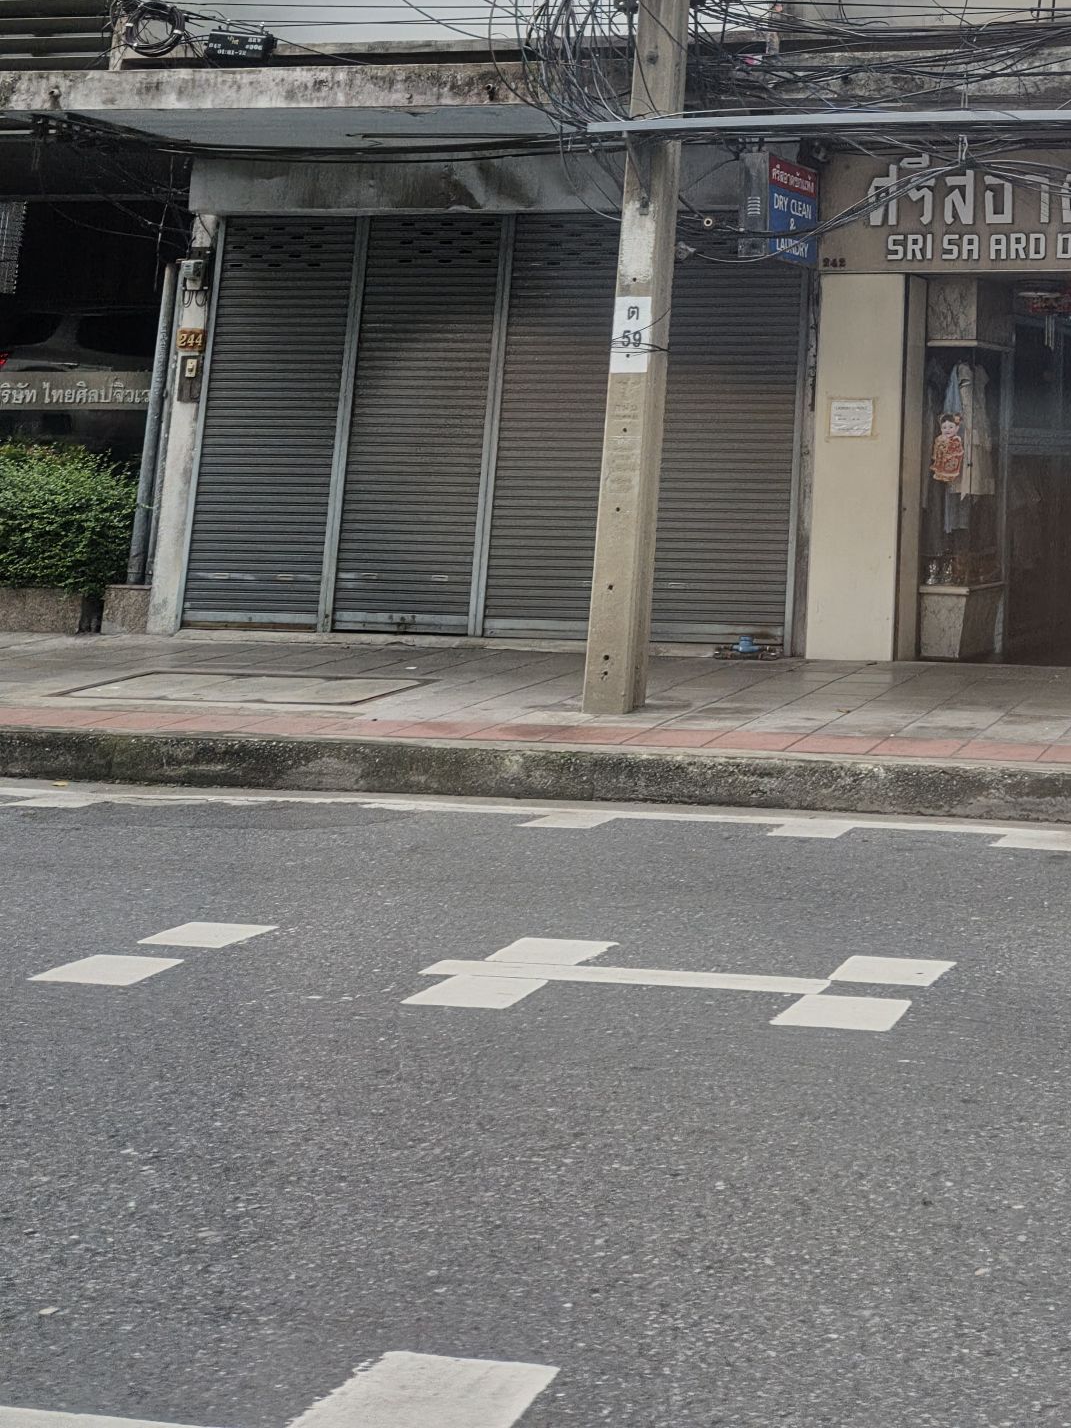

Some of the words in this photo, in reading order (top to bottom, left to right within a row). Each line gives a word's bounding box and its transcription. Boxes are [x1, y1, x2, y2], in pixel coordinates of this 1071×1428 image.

[774, 193, 789, 213] DRY
[790, 199, 812, 220] CLEAN
[789, 218, 796, 230] &
[887, 233, 932, 260] SRI
[942, 233, 979, 260] SA
[989, 232, 1046, 260] ARD
[179, 333, 203, 347] 244
[622, 330, 642, 347] 59
[0, 382, 37, 404] ริษัท
